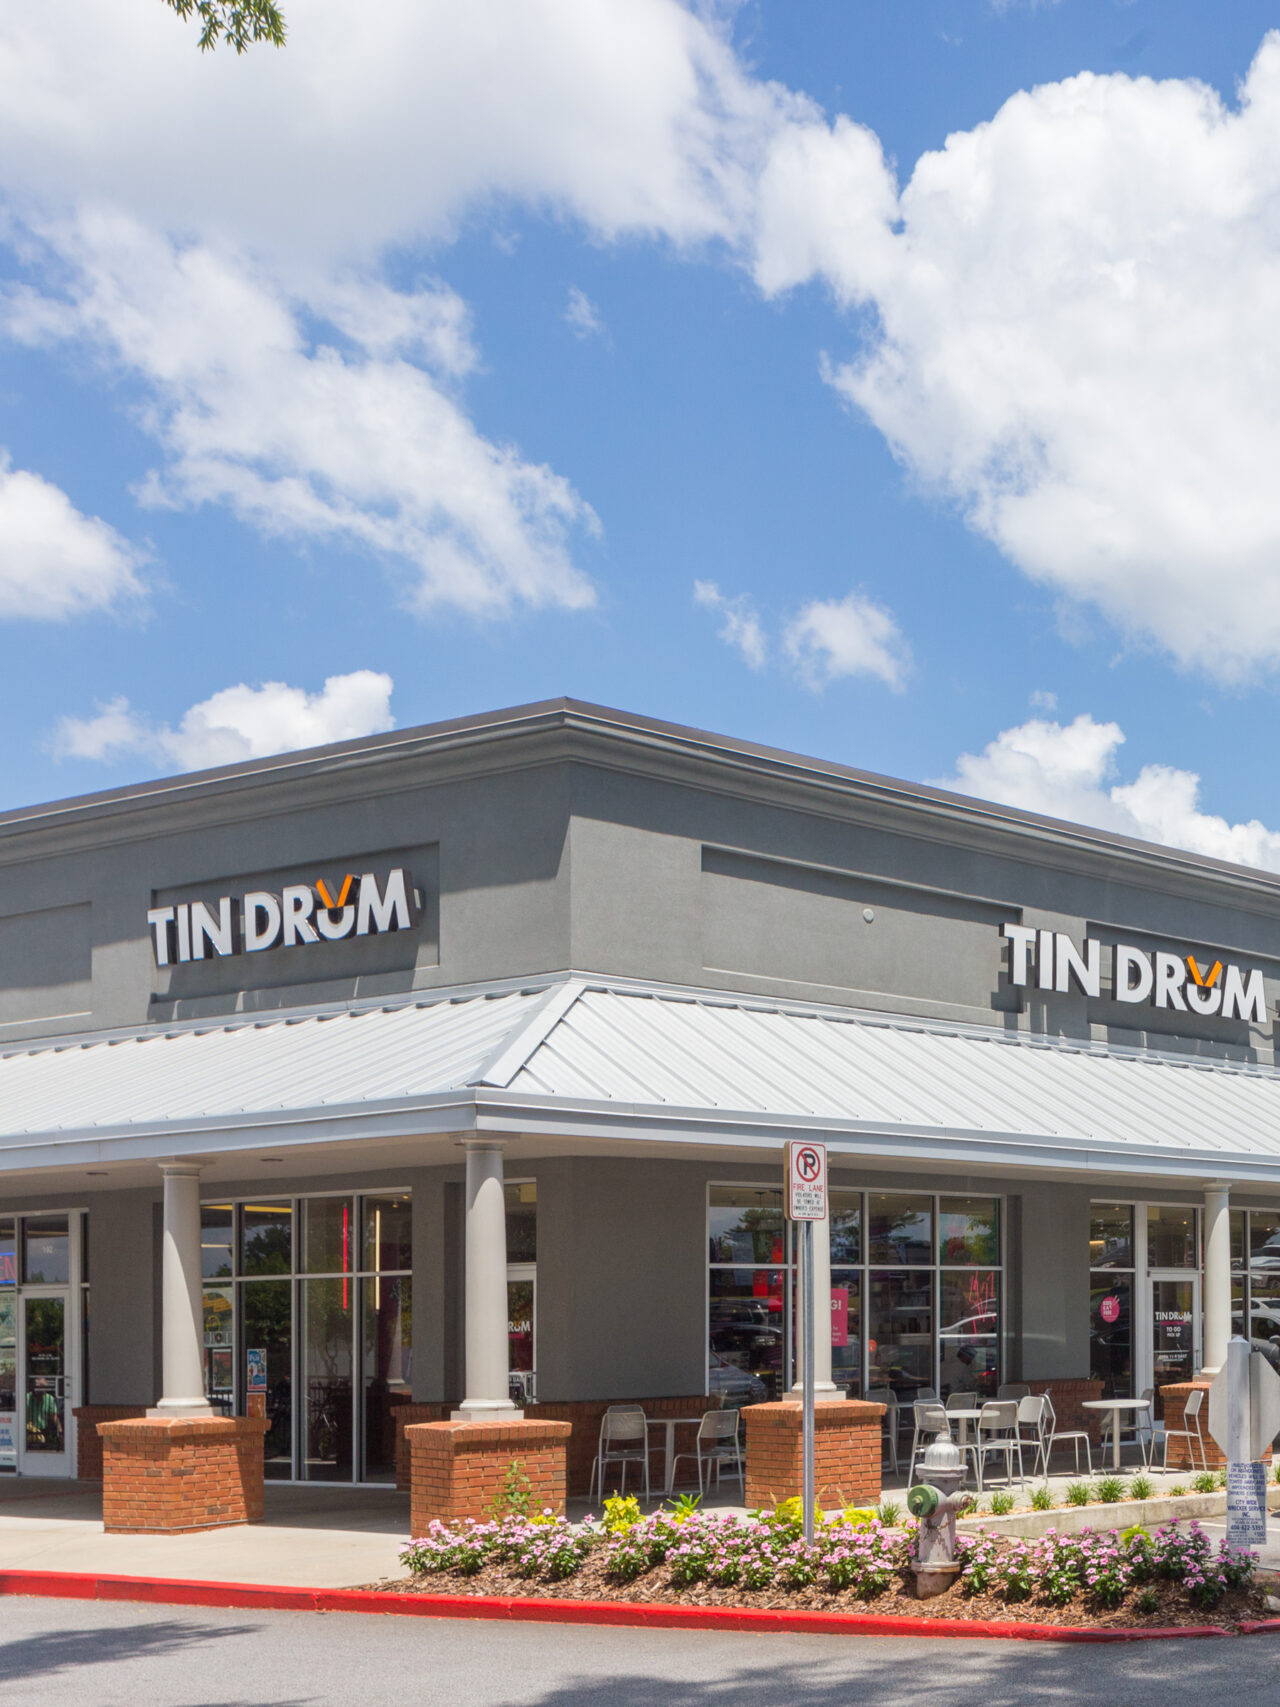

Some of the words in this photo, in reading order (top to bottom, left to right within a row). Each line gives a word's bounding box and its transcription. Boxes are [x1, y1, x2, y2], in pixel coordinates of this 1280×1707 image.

[147, 896, 234, 966] TIN
[244, 868, 411, 952] DRUM
[1001, 922, 1100, 998] TIN
[1112, 944, 1268, 1024] DRUM
[793, 1183, 805, 1192] FIRE
[808, 1184, 824, 1193] LANE
[1155, 1311, 1168, 1321] TIN
[1169, 1311, 1190, 1321] DRUM
[507, 1321, 531, 1332] RUM
